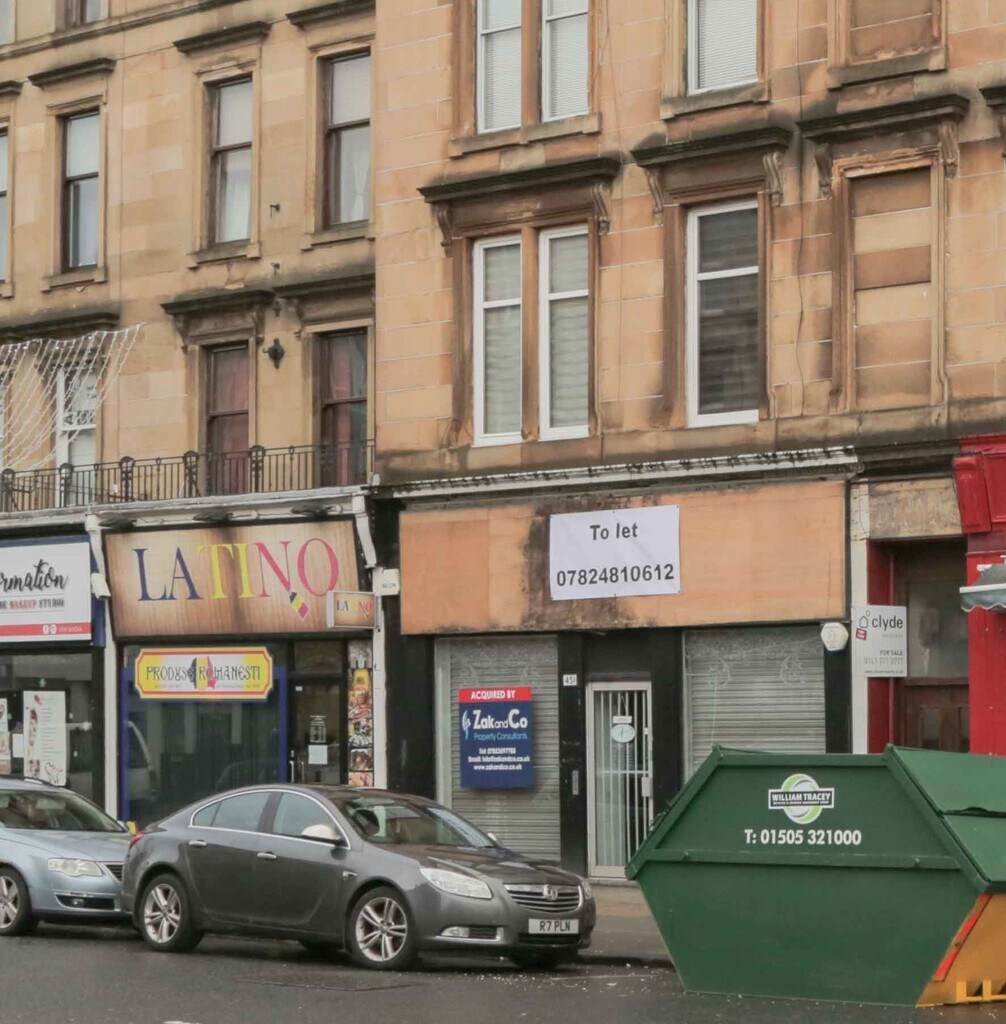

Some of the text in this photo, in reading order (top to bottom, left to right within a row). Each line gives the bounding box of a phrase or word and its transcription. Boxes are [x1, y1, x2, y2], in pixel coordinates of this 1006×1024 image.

[589, 522, 638, 541] To let
[132, 538, 339, 602] LATINO
[556, 563, 675, 587] 07824810612
[871, 614, 904, 631] clyde
[564, 676, 576, 685] 451
[471, 689, 516, 700] ACQUIRED BY
[473, 731, 528, 741] Property Consultants
[772, 792, 831, 802] WILLIAM TRACEY
[744, 829, 862, 846] T: 01505 321000
[539, 920, 571, 932] R7 PLN
